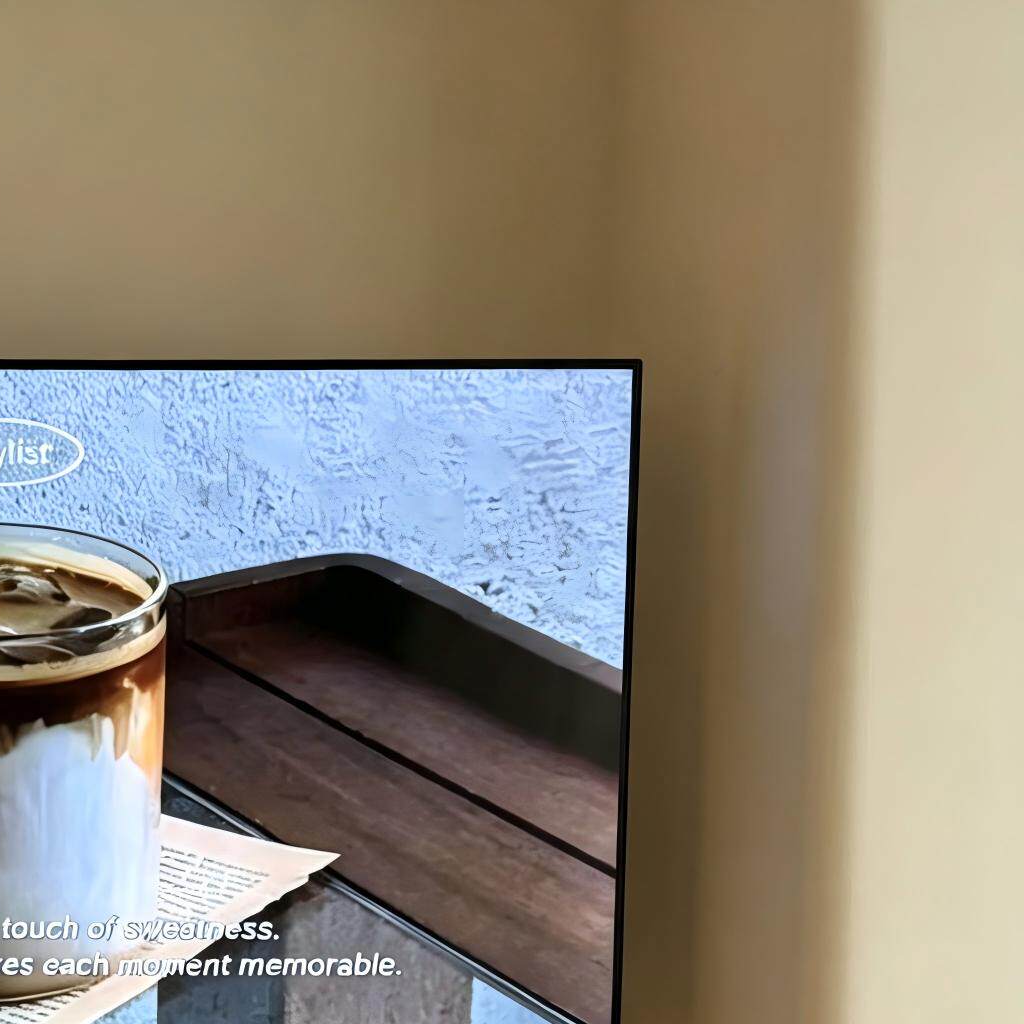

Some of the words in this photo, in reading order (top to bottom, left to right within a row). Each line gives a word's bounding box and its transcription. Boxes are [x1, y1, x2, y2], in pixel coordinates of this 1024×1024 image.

[1, 914, 79, 941] touch
[86, 914, 120, 942] of
[41, 951, 109, 977] each
[114, 953, 232, 977] moment
[238, 951, 403, 977] memorable.
